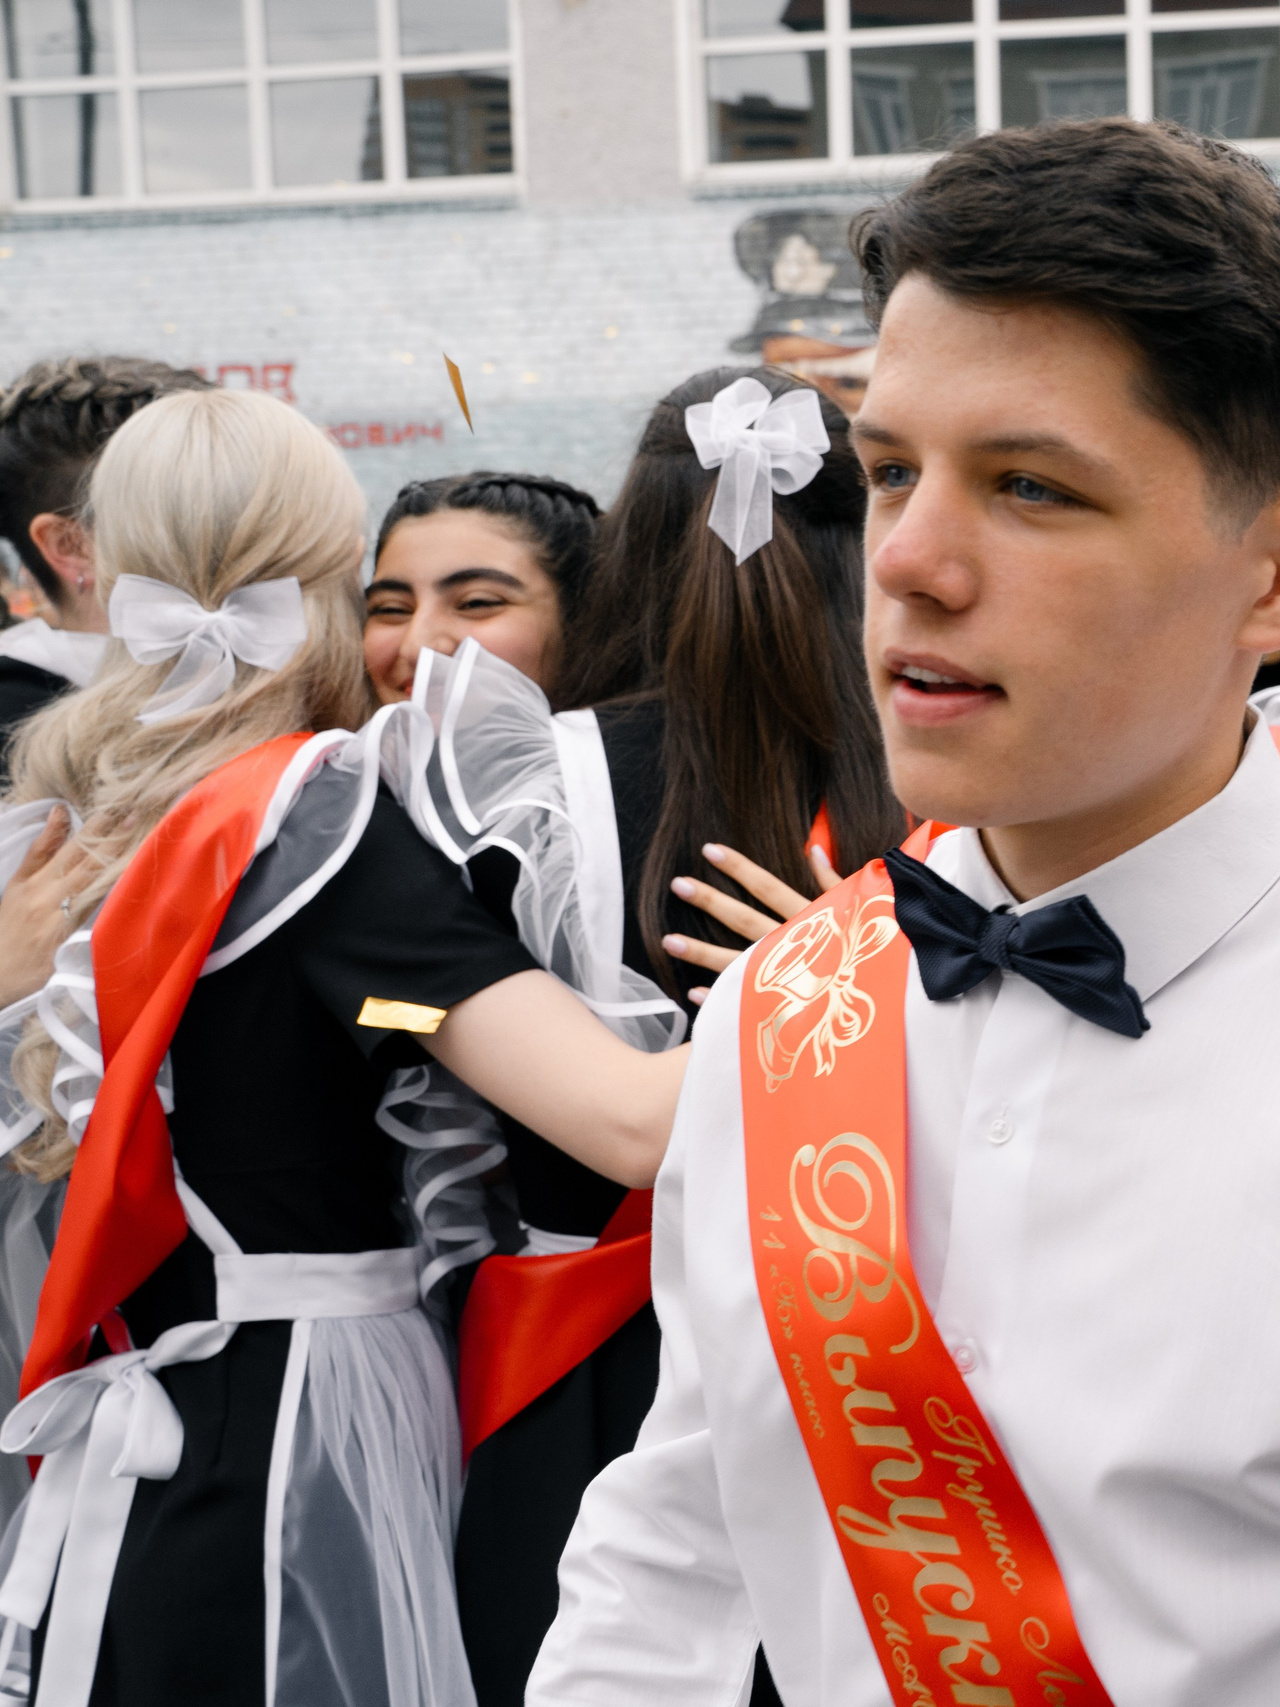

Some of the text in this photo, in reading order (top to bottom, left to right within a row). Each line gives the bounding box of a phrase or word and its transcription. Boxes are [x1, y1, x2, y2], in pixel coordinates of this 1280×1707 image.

[193, 362, 297, 404] ОВ
[326, 421, 444, 449] ОВИЧ
[923, 1396, 1023, 1595] Грушко
